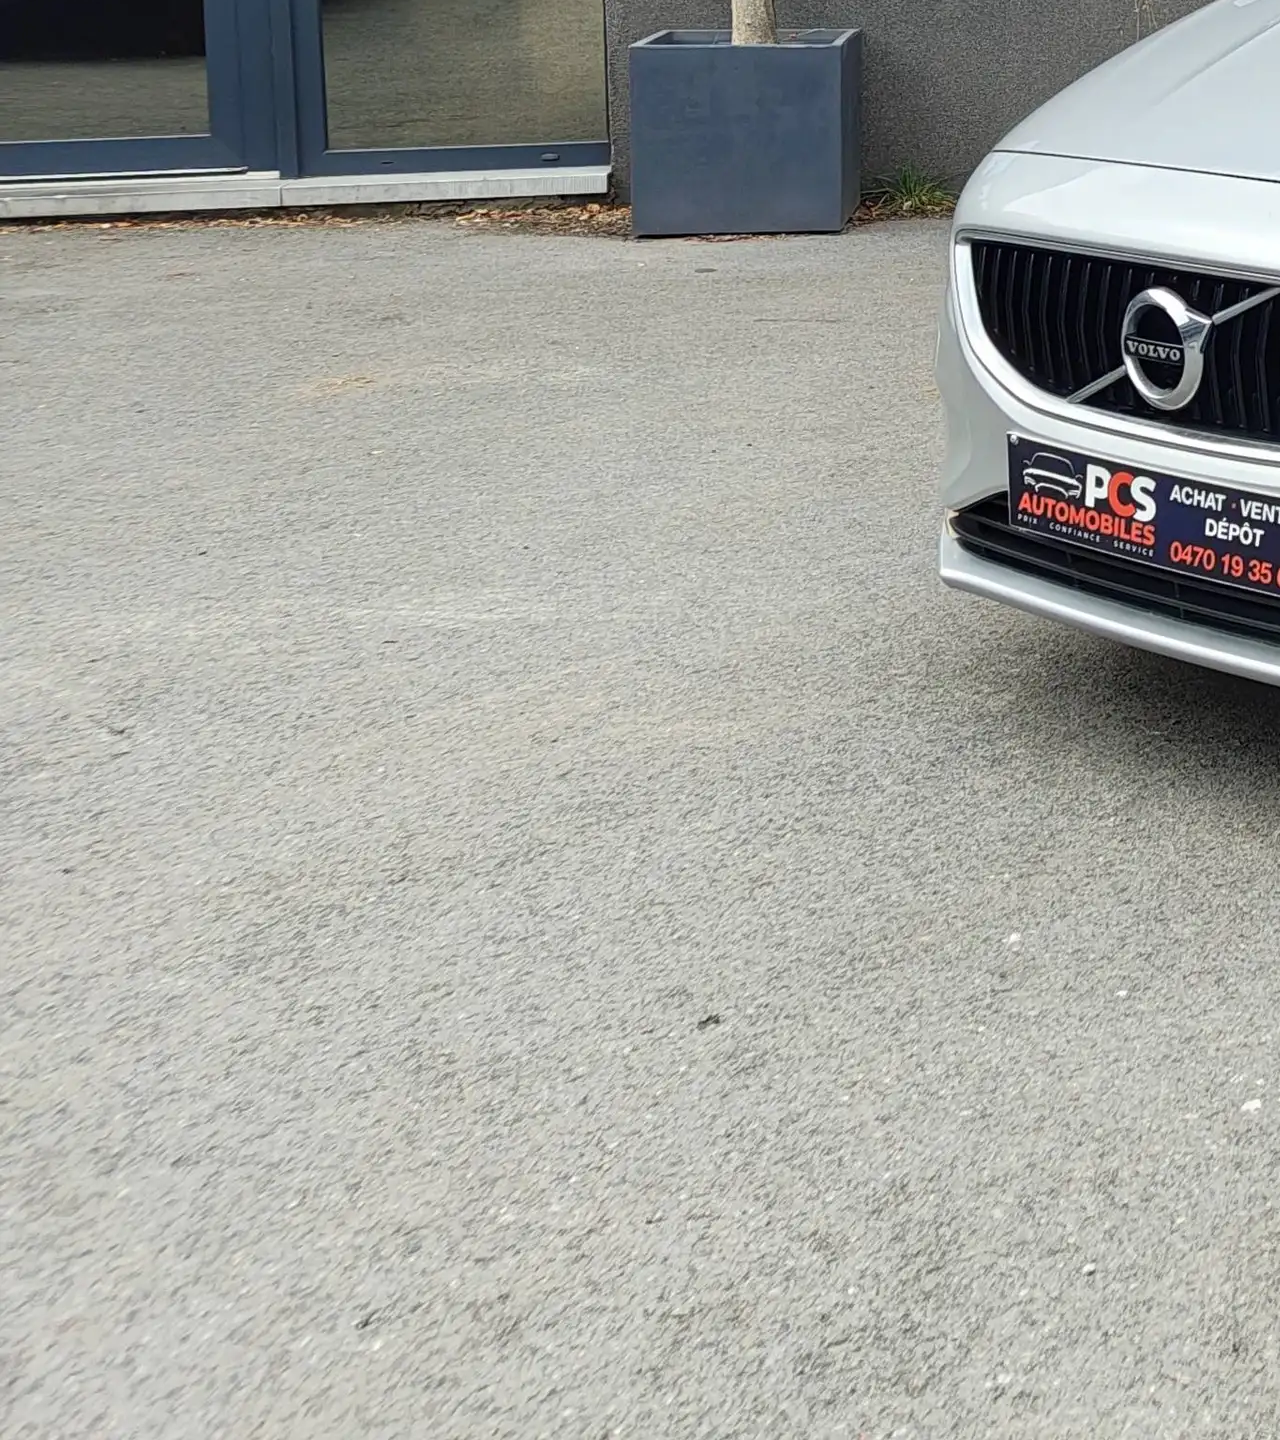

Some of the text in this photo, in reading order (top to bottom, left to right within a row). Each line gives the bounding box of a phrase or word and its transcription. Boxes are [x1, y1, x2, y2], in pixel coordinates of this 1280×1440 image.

[1126, 340, 1181, 361] VOLVO
[1084, 463, 1157, 522] PCS
[1169, 484, 1227, 512] ACHAT
[1017, 513, 1154, 557] PRIX CONFIANCE SERVICE
[1018, 492, 1156, 546] AUTOMOBILES
[1204, 517, 1265, 548] DÉPÔT
[1170, 540, 1216, 571] 0470
[1221, 553, 1244, 578] 19
[1248, 559, 1272, 585] 35
